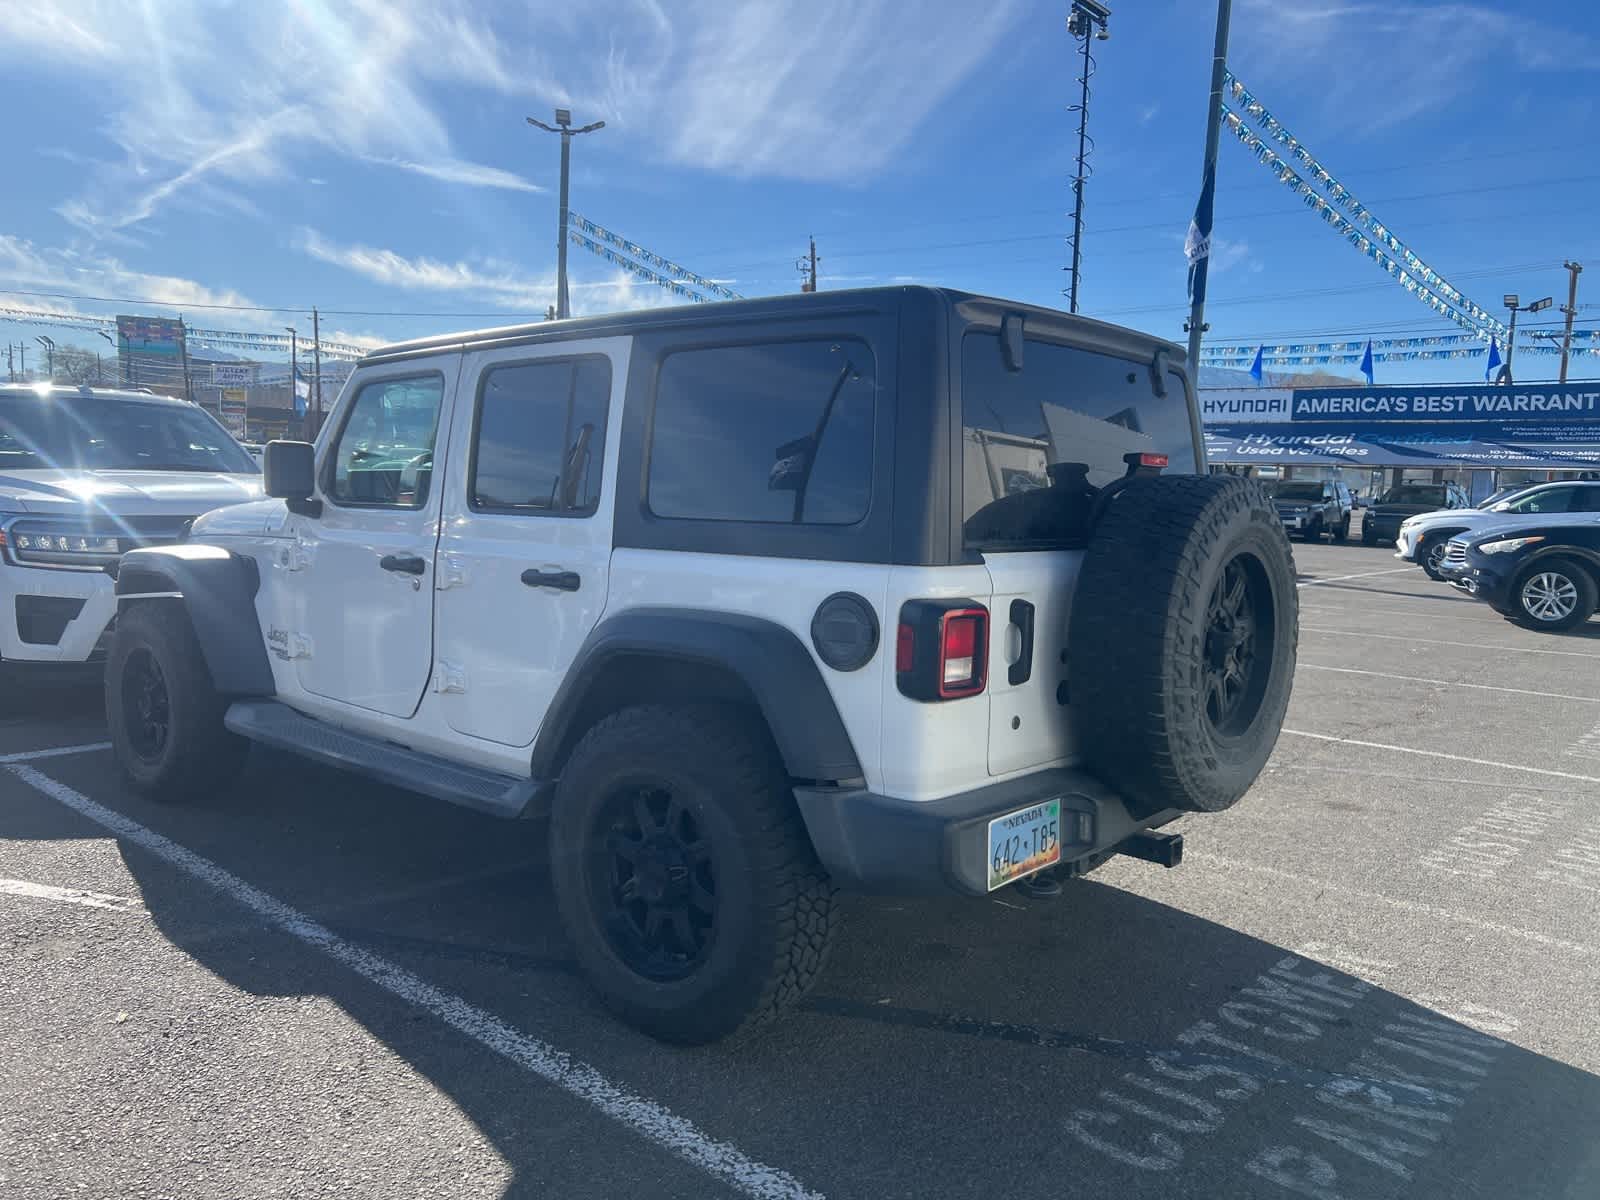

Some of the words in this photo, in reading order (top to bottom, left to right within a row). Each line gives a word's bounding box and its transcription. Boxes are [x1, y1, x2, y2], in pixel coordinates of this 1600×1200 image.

[1203, 399, 1287, 413] HYUNDAI
[1295, 397, 1408, 414] AMERICA'S
[1412, 396, 1469, 412] BEST
[1243, 433, 1356, 447] Hyundai
[1236, 446, 1285, 455] Used
[1007, 807, 1043, 829] NEVADA
